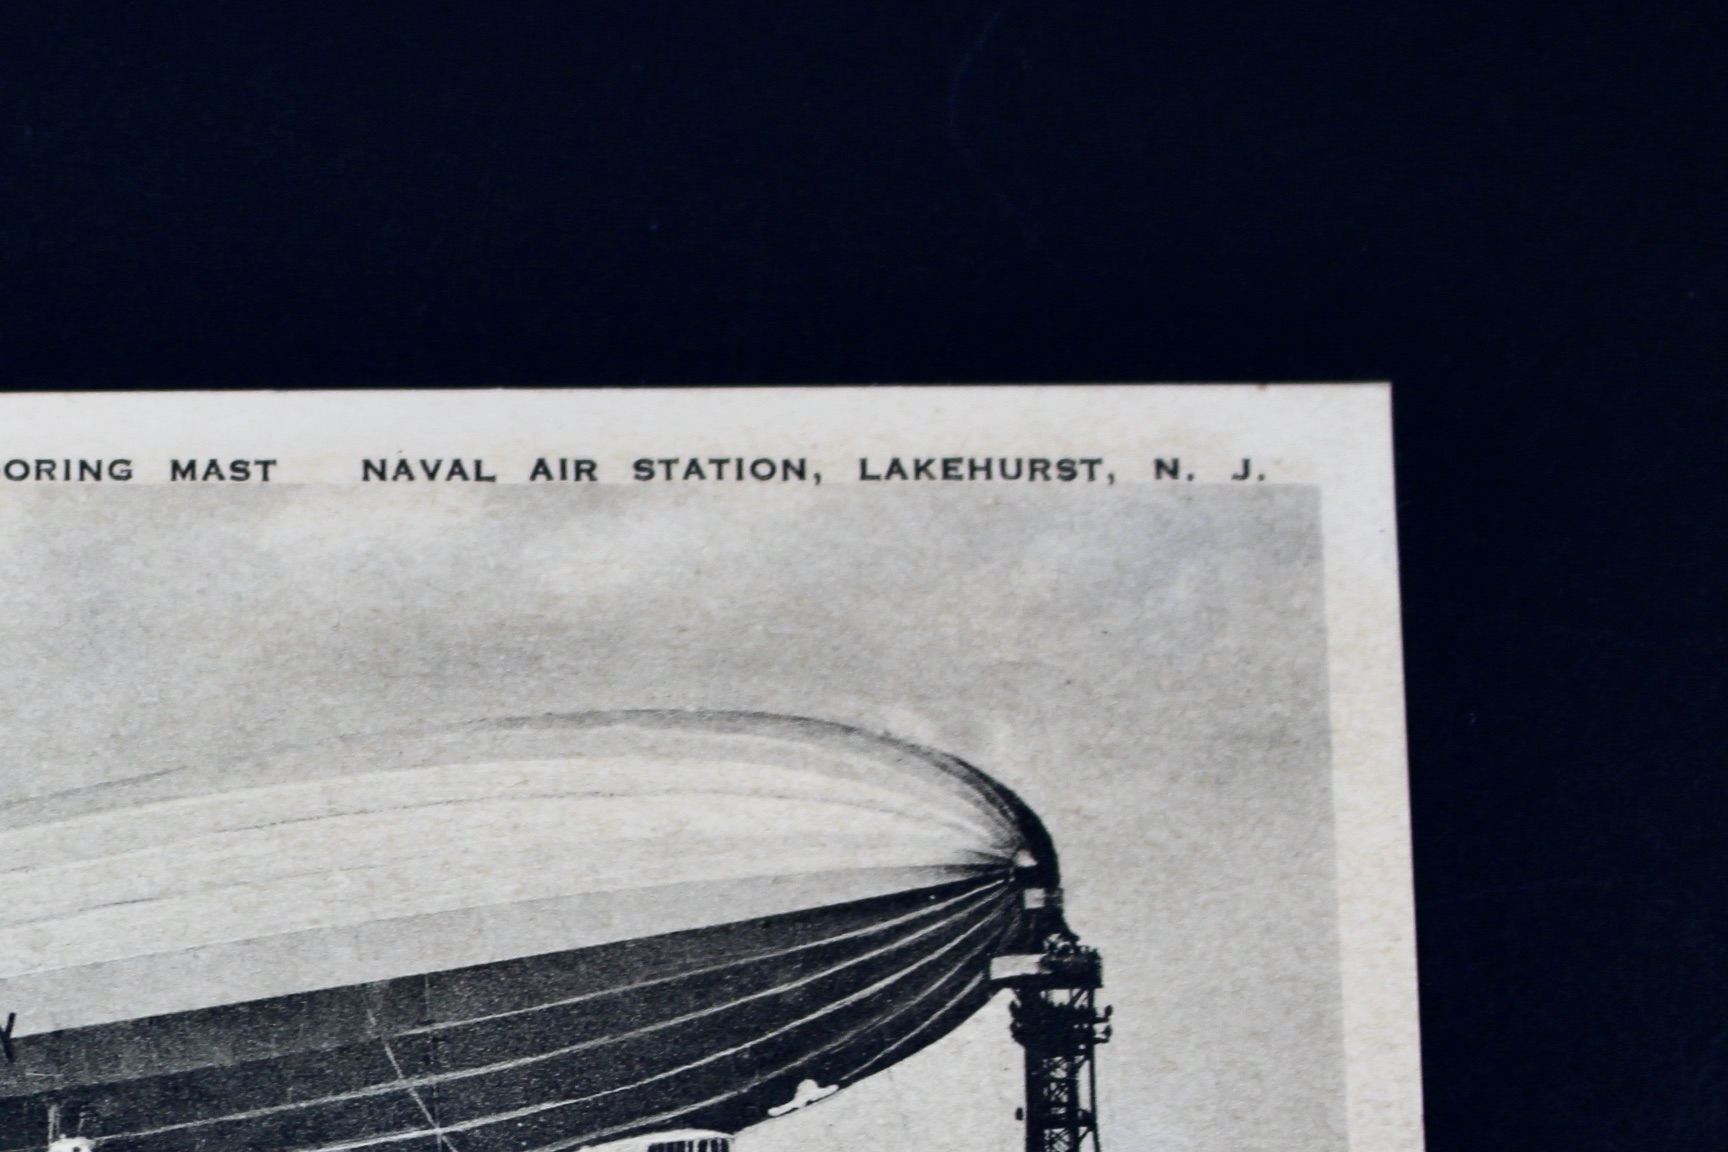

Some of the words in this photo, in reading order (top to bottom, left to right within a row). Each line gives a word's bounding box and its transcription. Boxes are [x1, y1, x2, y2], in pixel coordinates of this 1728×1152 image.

[170, 458, 278, 482] MAST
[361, 458, 497, 483] NAVAL
[529, 457, 599, 482] AIR
[632, 457, 822, 486] STATION,
[858, 457, 1116, 485] LAKEHURST,
[1154, 457, 1195, 482] N.
[1231, 457, 1267, 482] J.
